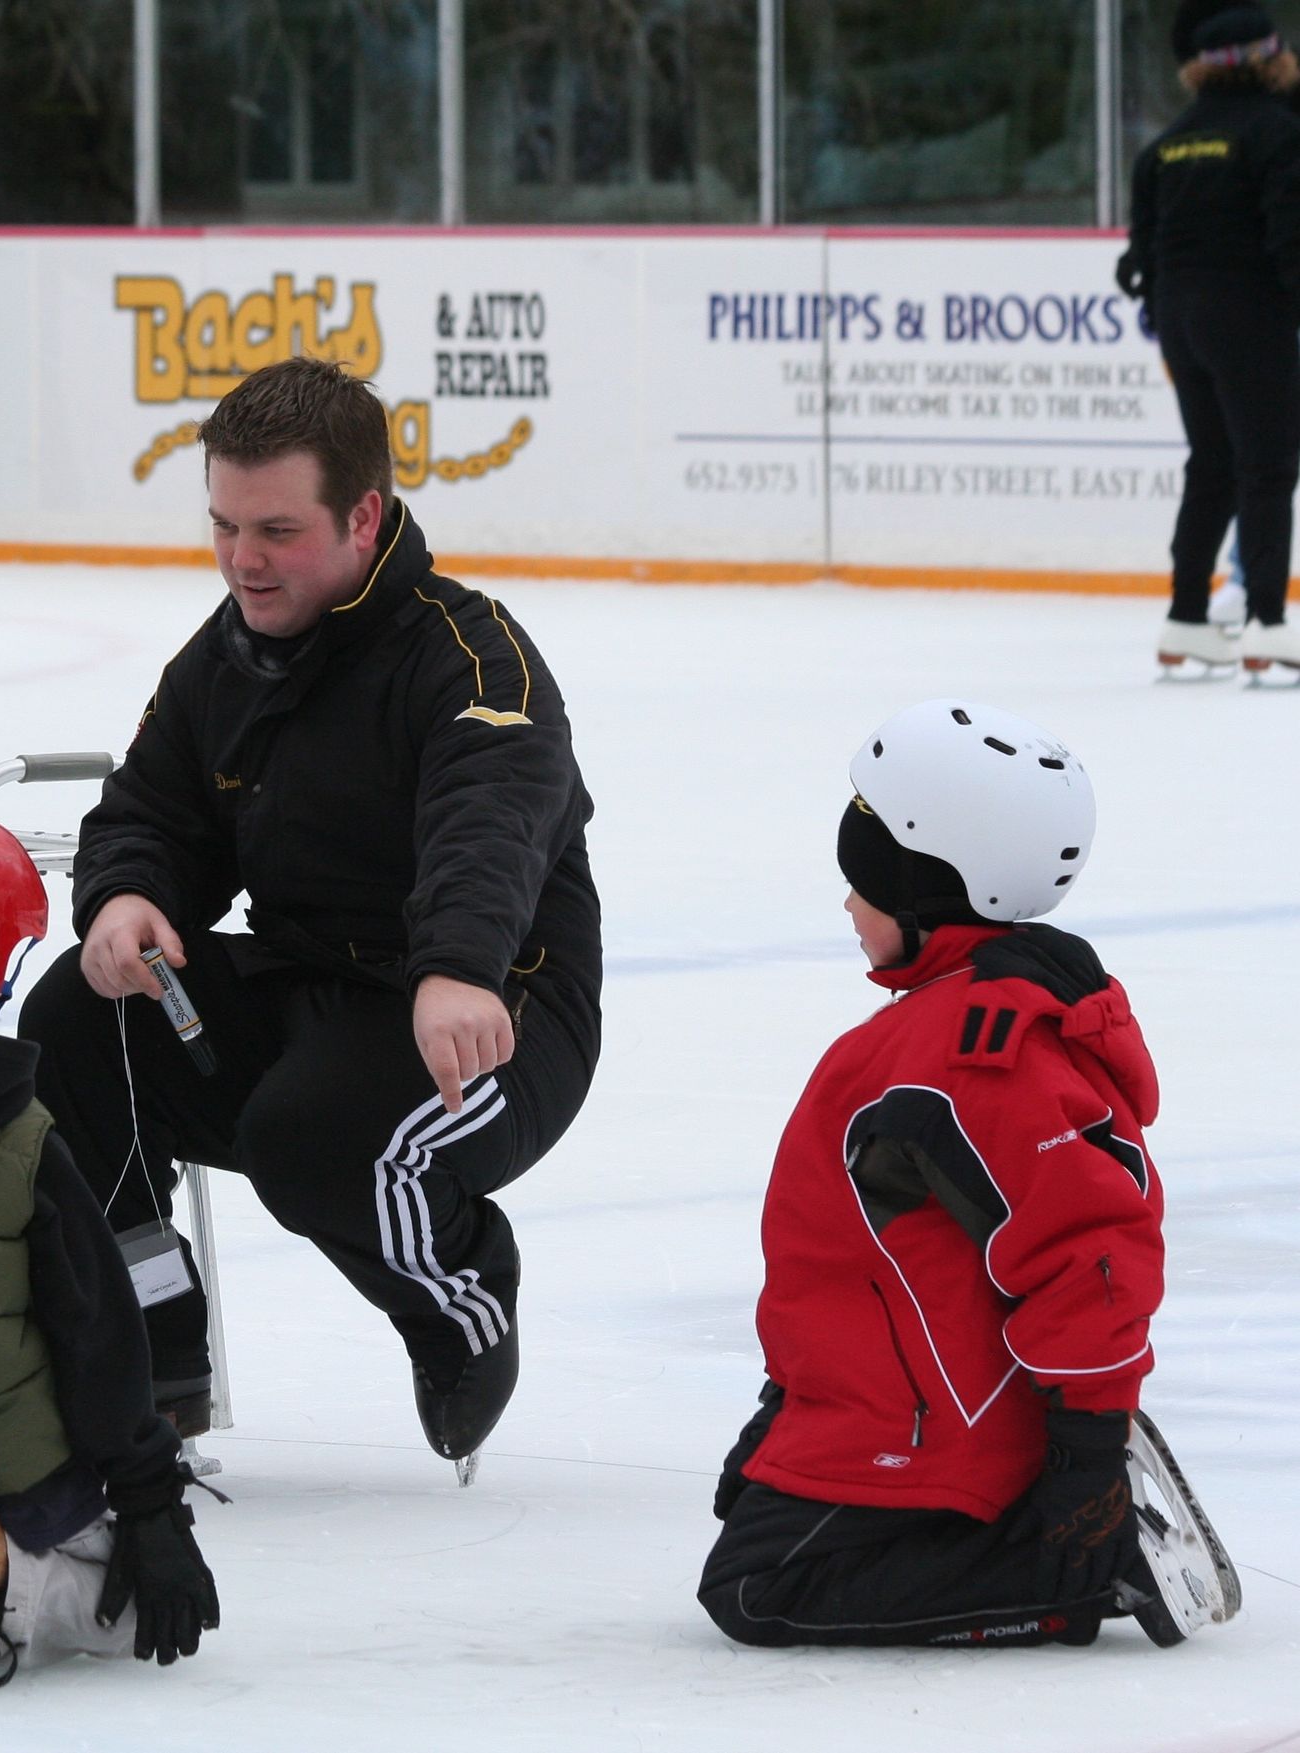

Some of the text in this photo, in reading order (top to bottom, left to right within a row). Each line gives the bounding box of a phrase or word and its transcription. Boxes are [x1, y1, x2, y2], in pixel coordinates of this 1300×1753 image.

[114, 273, 382, 401] Bach's
[436, 291, 546, 339] & AUTO
[709, 293, 883, 343] PHILIPPS
[895, 301, 926, 342] &
[944, 294, 1124, 344] BROOKS
[435, 351, 550, 398] REPAIR
[782, 360, 837, 387] TALK
[847, 361, 917, 387] ABOUT
[924, 361, 1014, 388] SKATING
[1019, 362, 1053, 388] ON
[1061, 363, 1111, 388] THIN
[868, 392, 951, 418] INCOME
[960, 393, 1001, 418] TAX
[1010, 394, 1039, 419] TO
[1046, 394, 1082, 420] THE
[864, 462, 948, 498] RILEY
[1071, 466, 1143, 501] EAST
